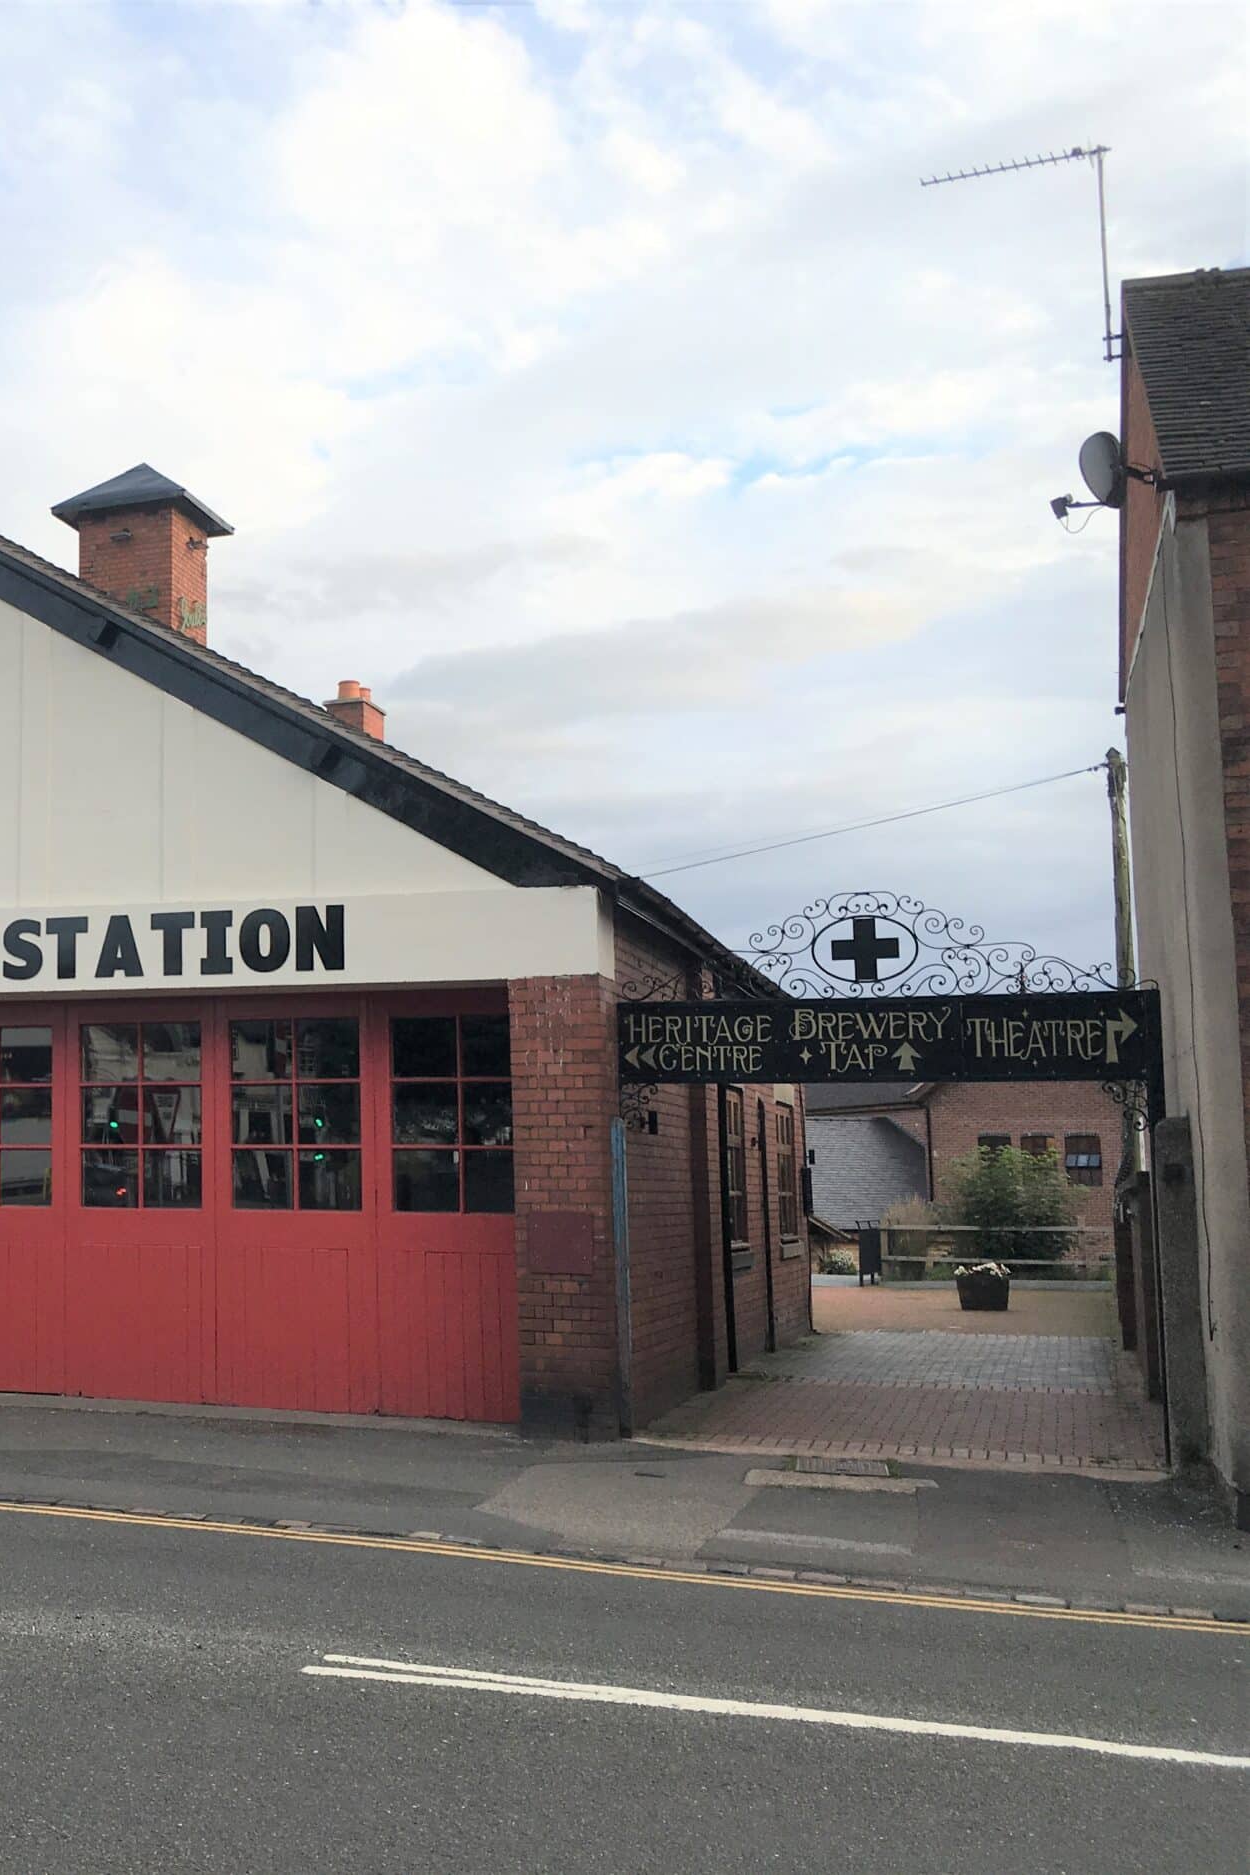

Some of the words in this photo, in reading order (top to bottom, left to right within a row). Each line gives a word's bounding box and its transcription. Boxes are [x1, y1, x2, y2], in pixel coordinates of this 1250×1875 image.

[2, 904, 346, 981] STATION
[629, 1014, 773, 1045] HERITAGE
[788, 1006, 952, 1042] BREWERY
[966, 1017, 1103, 1060] THEATRE
[658, 1043, 763, 1074] CENTRE
[820, 1041, 888, 1072] TAP
